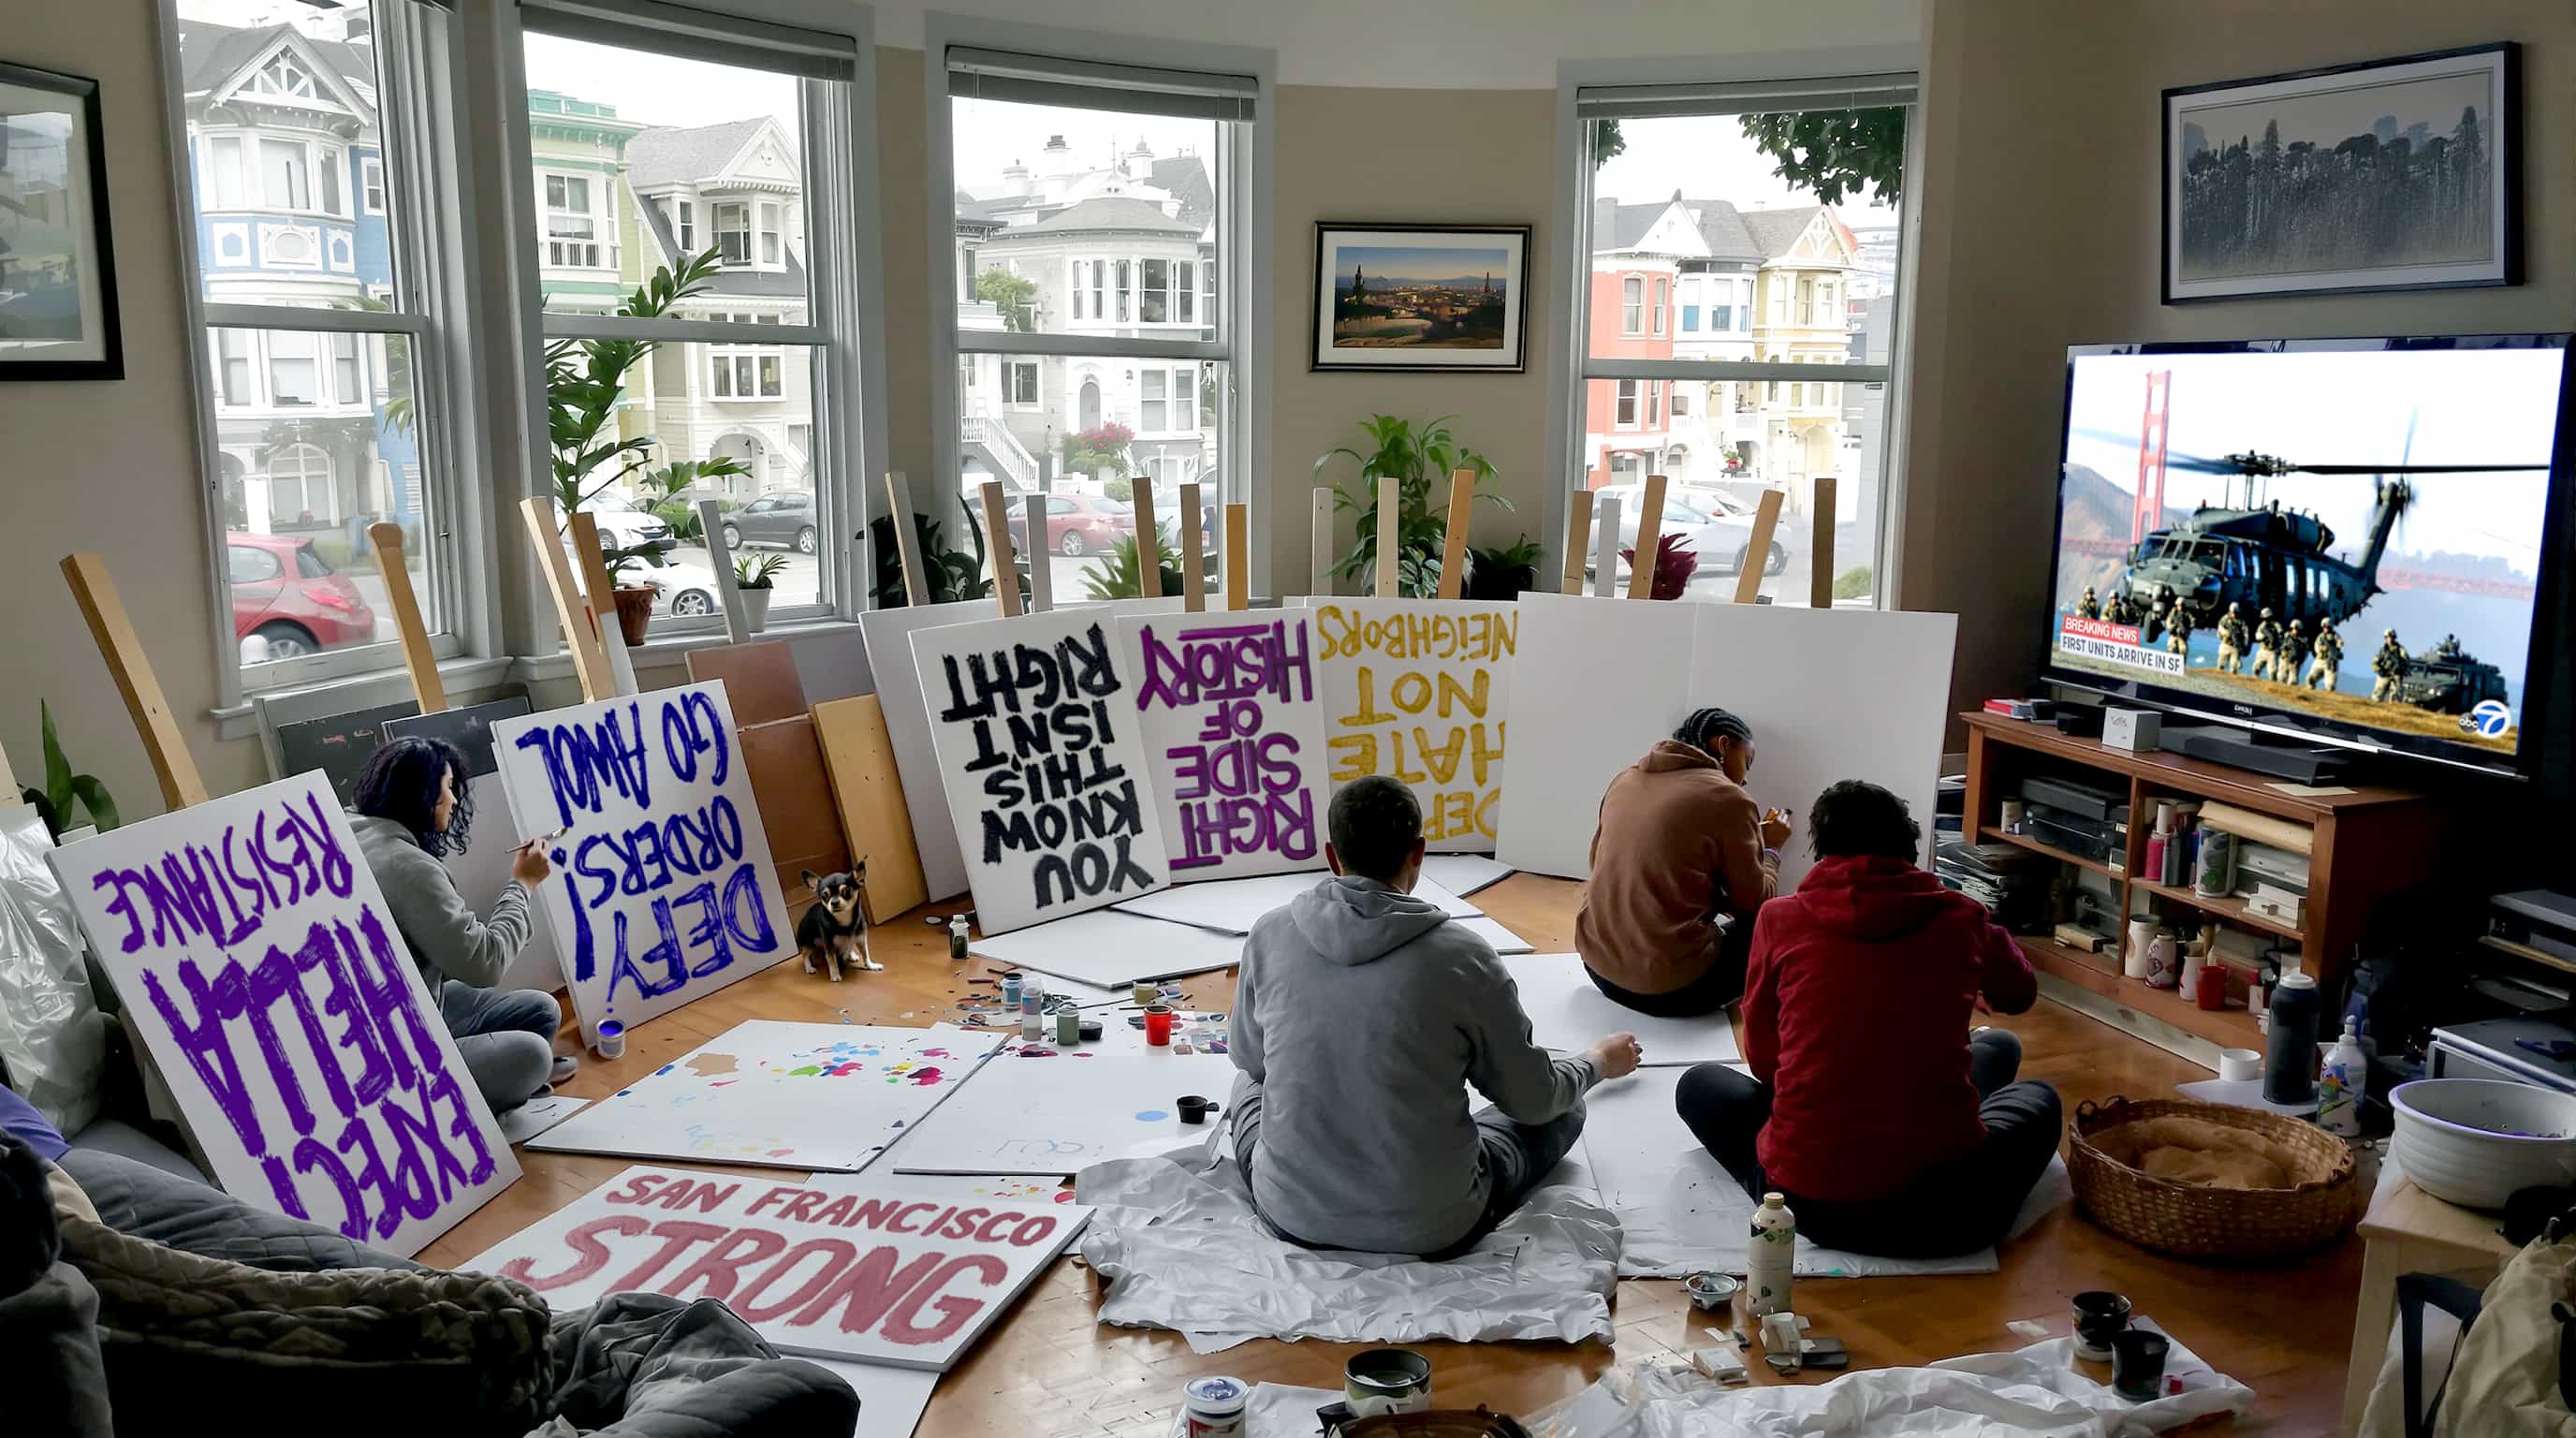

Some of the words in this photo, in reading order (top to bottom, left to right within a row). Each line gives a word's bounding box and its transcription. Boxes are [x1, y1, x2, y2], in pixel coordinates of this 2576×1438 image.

[1137, 619, 1313, 711] HISTORY
[2062, 637, 2086, 653] FIRST
[2088, 639, 2115, 658] UNITS
[2116, 647, 2153, 666] ARRIVE
[2155, 654, 2166, 669] IN
[2167, 657, 2180, 672] SF
[2065, 618, 2110, 638] BREAKING
[2111, 627, 2138, 642] NEWS
[942, 622, 1121, 722] RIGHT
[1339, 667, 1489, 726] NOT
[662, 691, 728, 786] GO
[1199, 700, 1263, 741] OF
[1327, 721, 1505, 786] HATE
[2458, 716, 2479, 728] abc
[2474, 707, 2509, 738] 7
[516, 700, 650, 828] AWOL
[984, 745, 1126, 809] THIS
[1166, 732, 1301, 800] SIDE
[982, 779, 1142, 866] KNOW
[1169, 788, 1317, 869] RIGHT
[94, 789, 354, 953] RESISTANCE
[1033, 834, 1155, 908] YOU
[607, 864, 778, 1004] DEFY
[139, 902, 443, 1157] HELLA
[607, 1172, 741, 1215] SAN
[744, 1186, 1059, 1247] FRANCISCO
[498, 1215, 1008, 1345] STRONG
